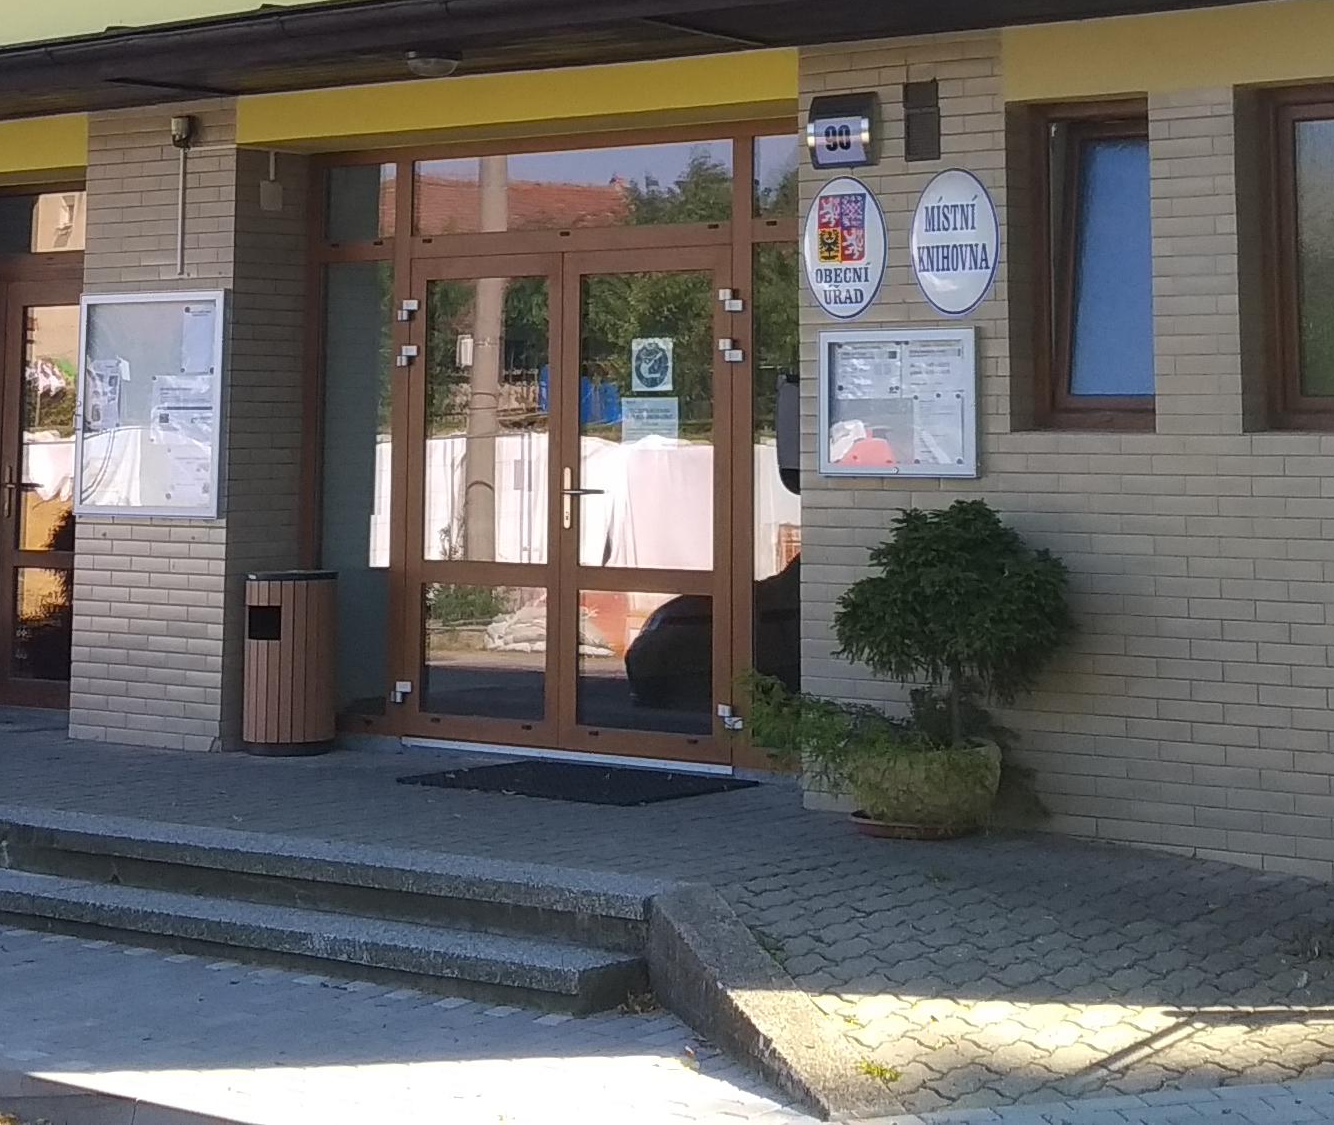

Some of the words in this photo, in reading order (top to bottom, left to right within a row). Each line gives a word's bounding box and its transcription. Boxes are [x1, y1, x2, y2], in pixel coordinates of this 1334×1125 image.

[824, 124, 851, 152] 90
[923, 195, 978, 233] MÍSTNÍ
[917, 242, 990, 273] KNIHOVNA
[815, 262, 870, 284] OBECNÍ
[823, 283, 865, 305] ÚŘAD
